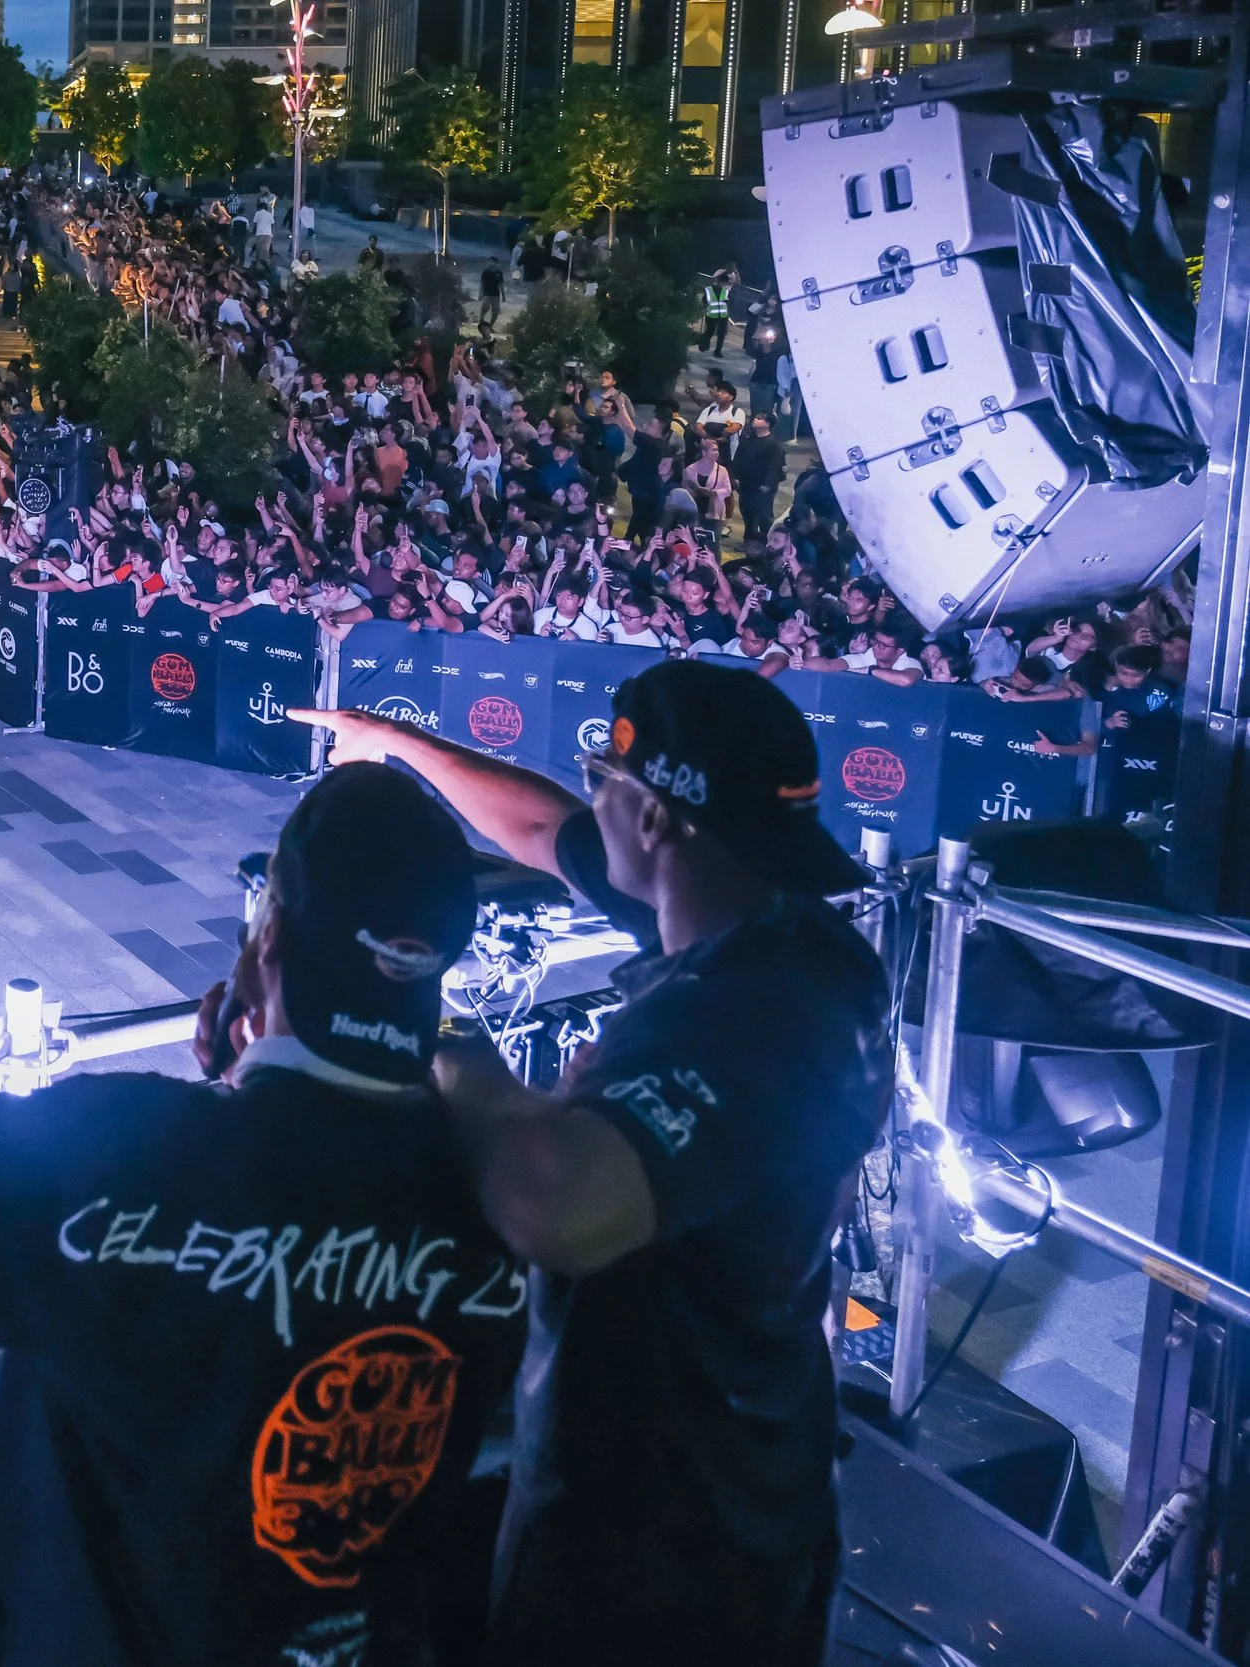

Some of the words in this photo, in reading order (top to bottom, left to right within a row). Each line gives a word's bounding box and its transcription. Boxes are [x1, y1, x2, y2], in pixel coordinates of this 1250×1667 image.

[265, 646, 302, 660] CAMBODIA
[399, 707, 440, 730] Rock
[331, 1013, 383, 1041] Hard
[383, 1023, 420, 1057] Rock
[57, 1197, 458, 1348] CELEBRATING
[285, 1421, 441, 1485] BALL
